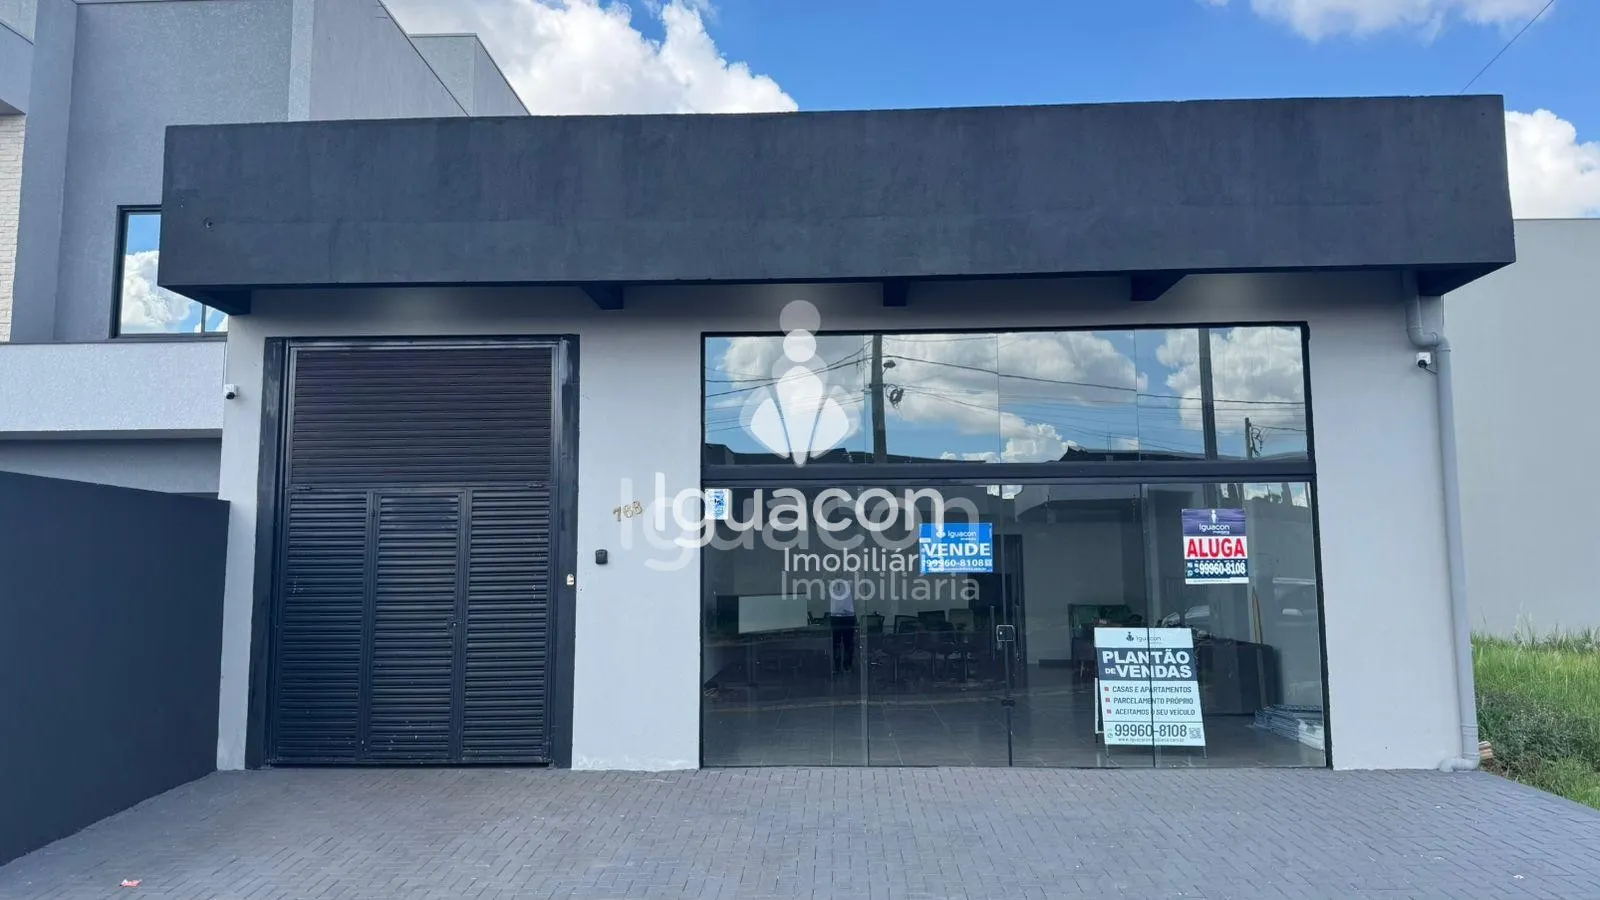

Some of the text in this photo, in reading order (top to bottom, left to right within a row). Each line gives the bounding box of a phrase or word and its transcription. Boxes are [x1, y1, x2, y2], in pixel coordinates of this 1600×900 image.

[923, 543, 990, 556] VENDE
[1187, 538, 1245, 557] ALUGA
[926, 559, 984, 567] 99960-8108
[1199, 562, 1246, 575] 99960-8108
[1102, 649, 1190, 664] PLANTÃO
[1115, 665, 1192, 678] VENDAS
[1166, 697, 1193, 705] PRÓPRIO
[1170, 707, 1195, 716] VEÍCULO
[1114, 724, 1187, 737] 99960-8108
